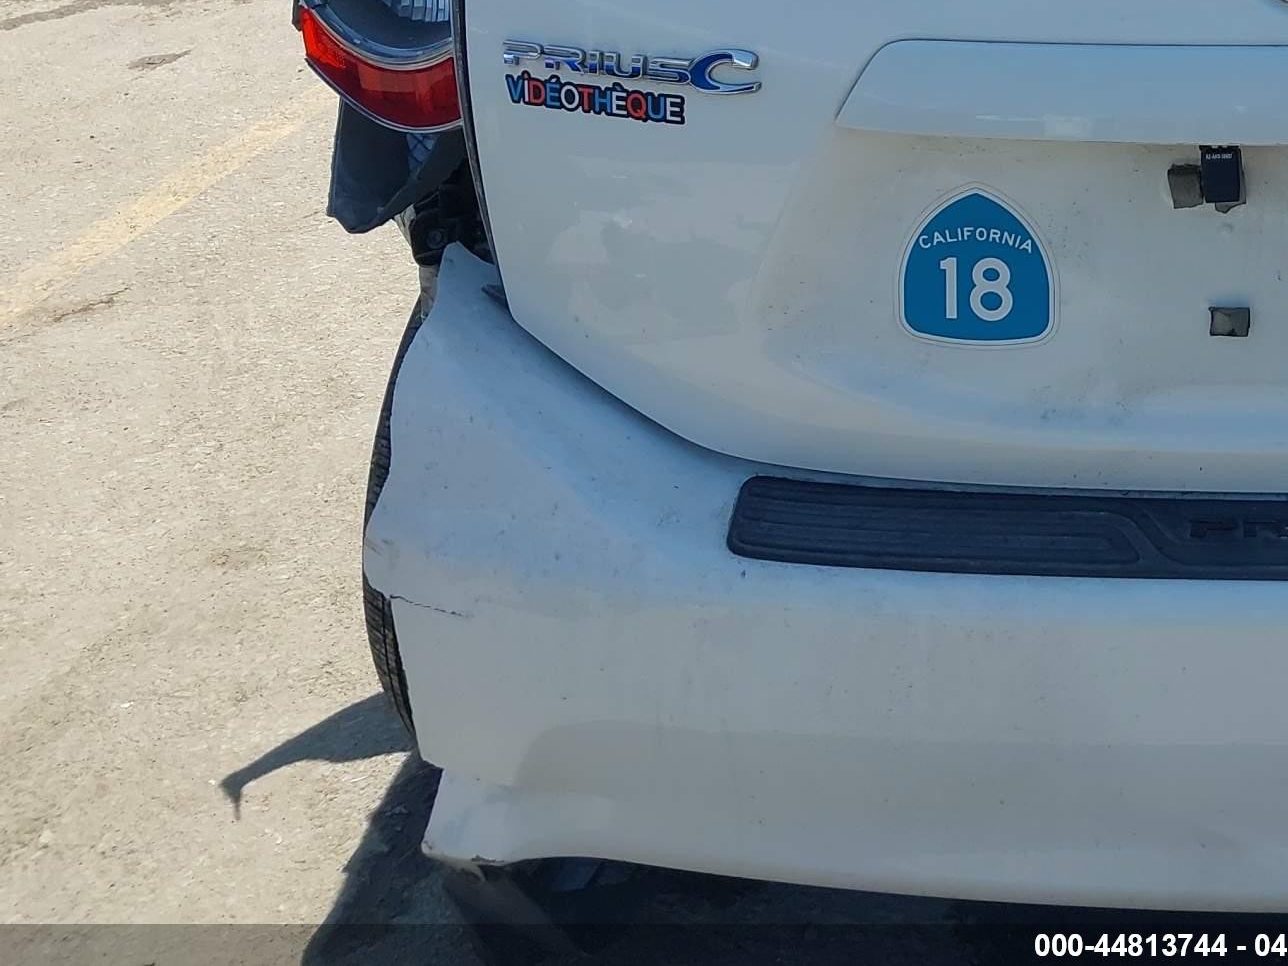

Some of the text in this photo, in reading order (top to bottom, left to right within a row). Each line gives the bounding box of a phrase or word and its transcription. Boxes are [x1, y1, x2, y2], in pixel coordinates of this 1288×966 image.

[502, 39, 762, 95] PRIUS C
[918, 226, 1032, 254] CALIFORNIA
[939, 257, 1013, 322] 18
